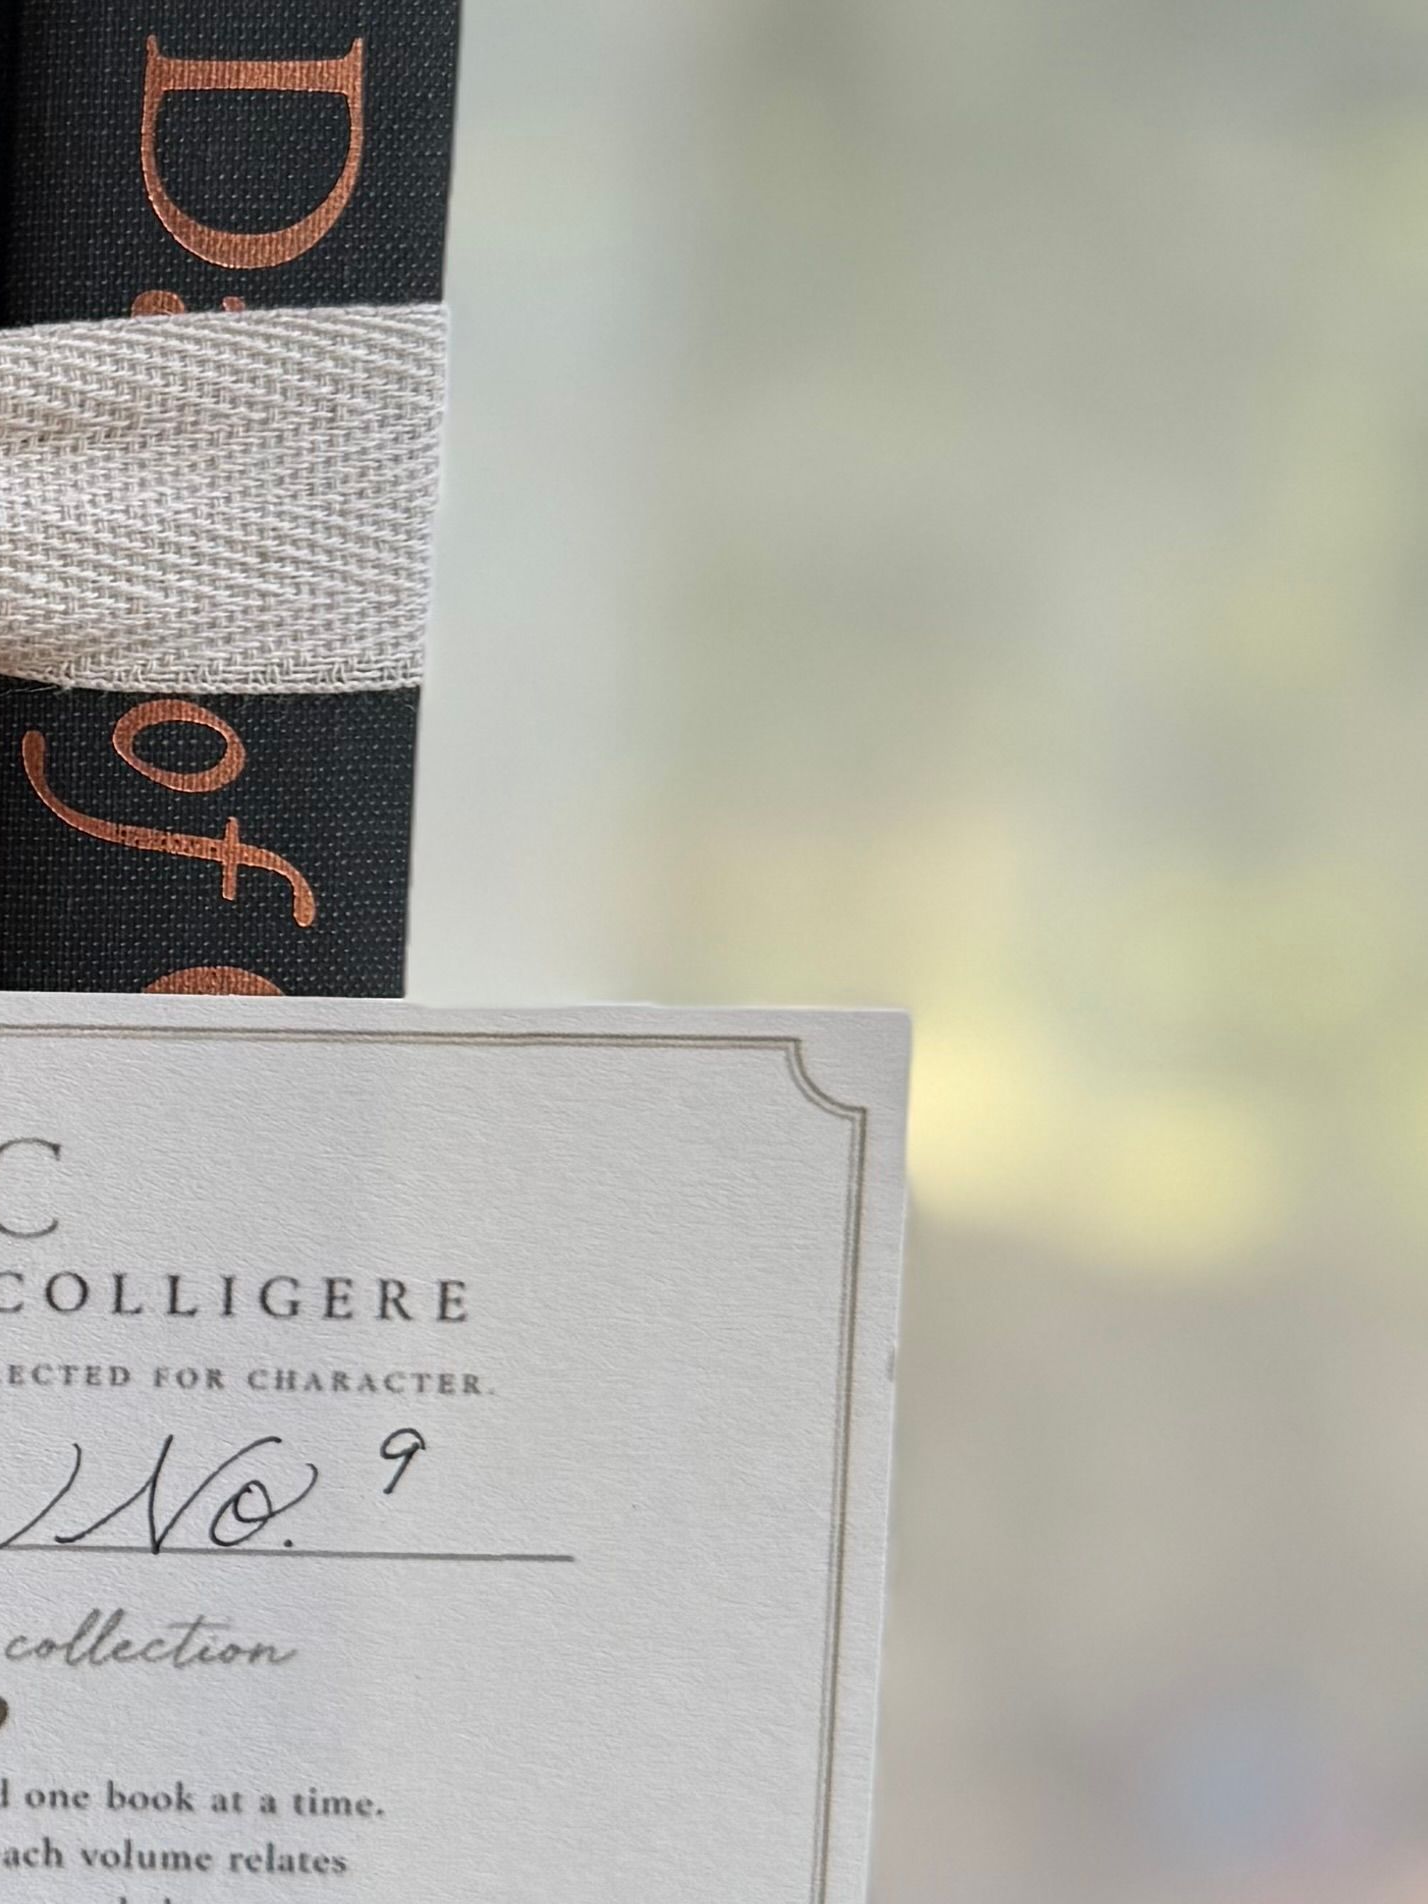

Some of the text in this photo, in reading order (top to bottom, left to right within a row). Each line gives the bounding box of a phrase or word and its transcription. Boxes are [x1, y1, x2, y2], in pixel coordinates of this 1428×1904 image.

[21, 698, 316, 928] of
[151, 1365, 227, 1392] FOR
[244, 1366, 493, 1397] CHARACTER.
[55, 1432, 320, 1556] No.
[377, 1425, 430, 1498] 9
[2, 1608, 300, 1672] collection
[22, 1787, 92, 1812] one
[104, 1777, 197, 1815] book
[208, 1790, 245, 1817] at
[257, 1792, 280, 1818] a
[291, 1785, 386, 1820] time.
[78, 1836, 215, 1875] volume
[227, 1839, 351, 1878] relates
